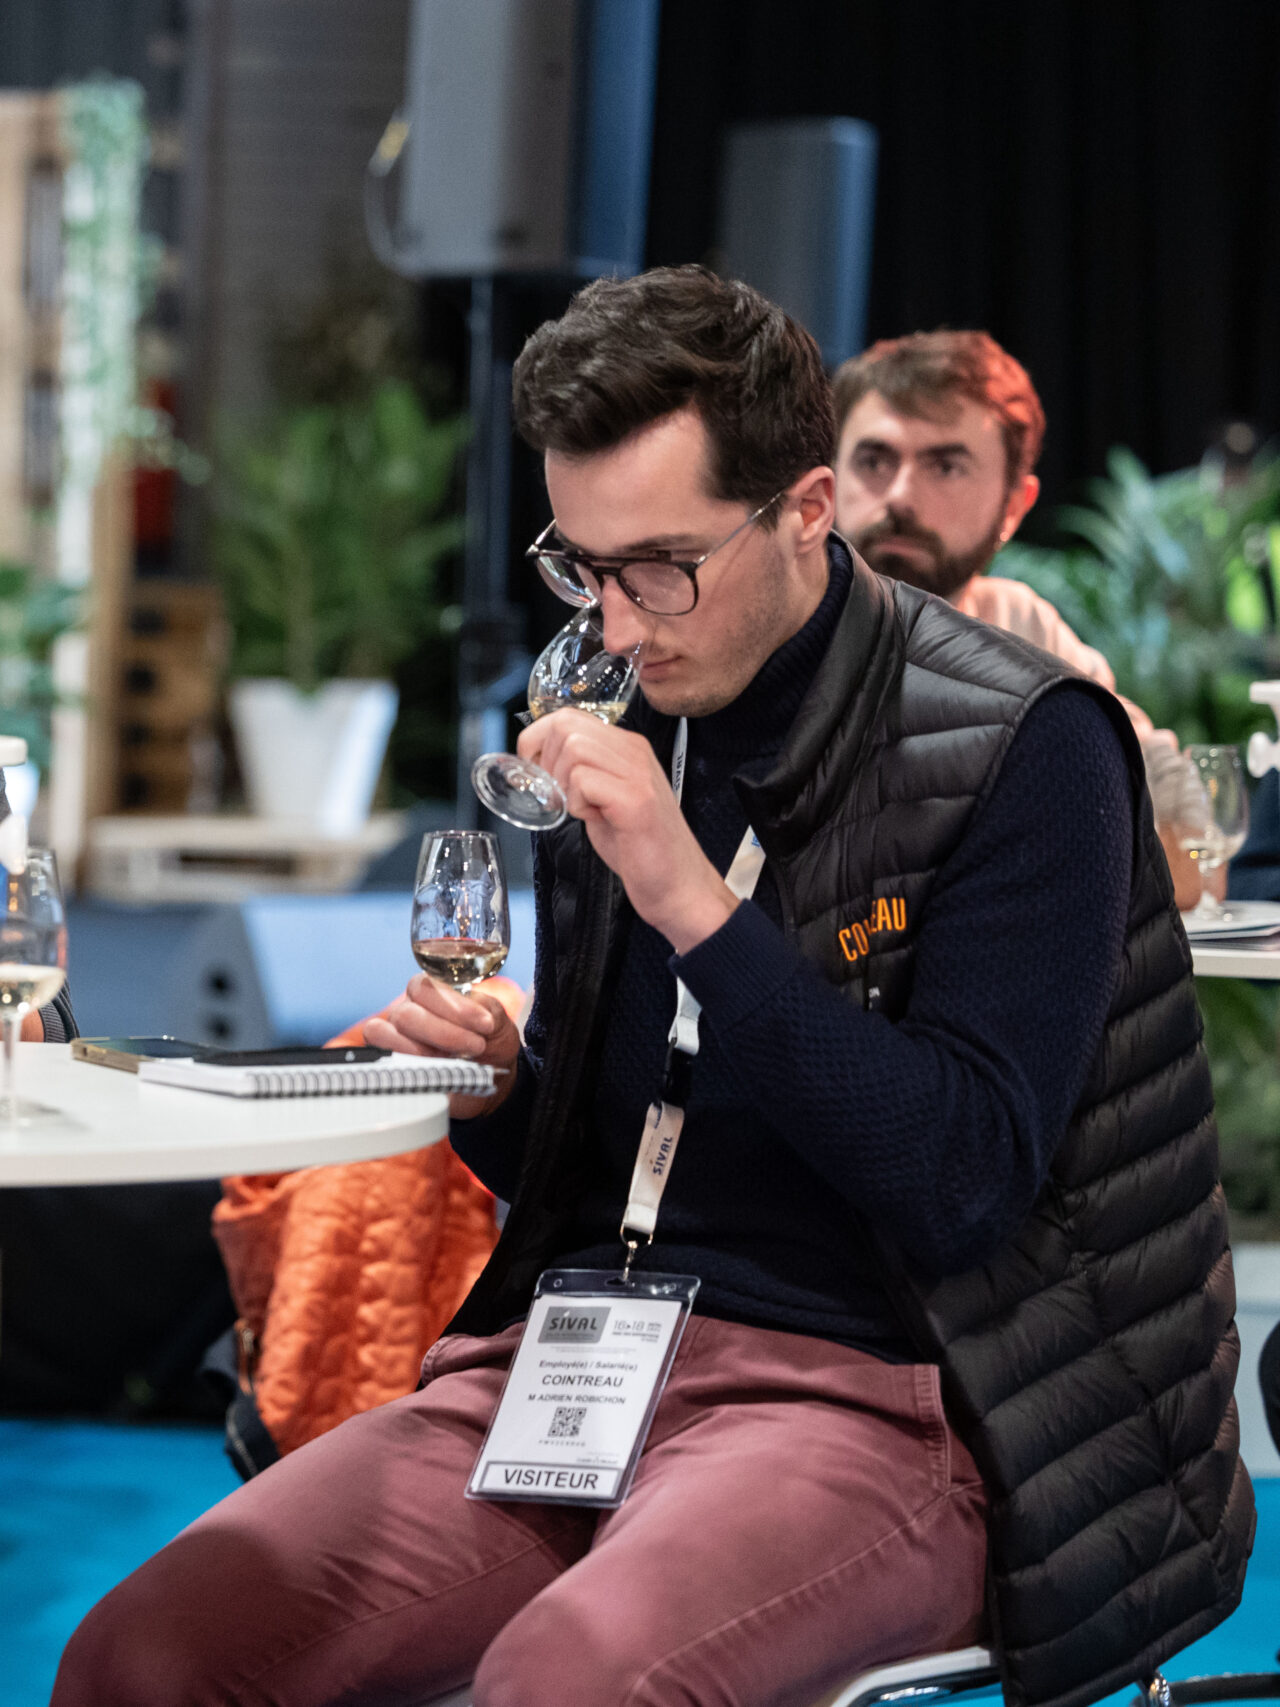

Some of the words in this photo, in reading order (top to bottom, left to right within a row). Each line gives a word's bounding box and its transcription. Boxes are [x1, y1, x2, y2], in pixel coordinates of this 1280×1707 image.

[653, 1136, 673, 1176] SIVAL
[549, 1317, 598, 1331] SIVAL
[542, 1374, 624, 1388] COINTREAU
[538, 1394, 573, 1403] ADRIEN
[575, 1395, 626, 1405] ROBICHON
[504, 1469, 599, 1489] VISITEUR
